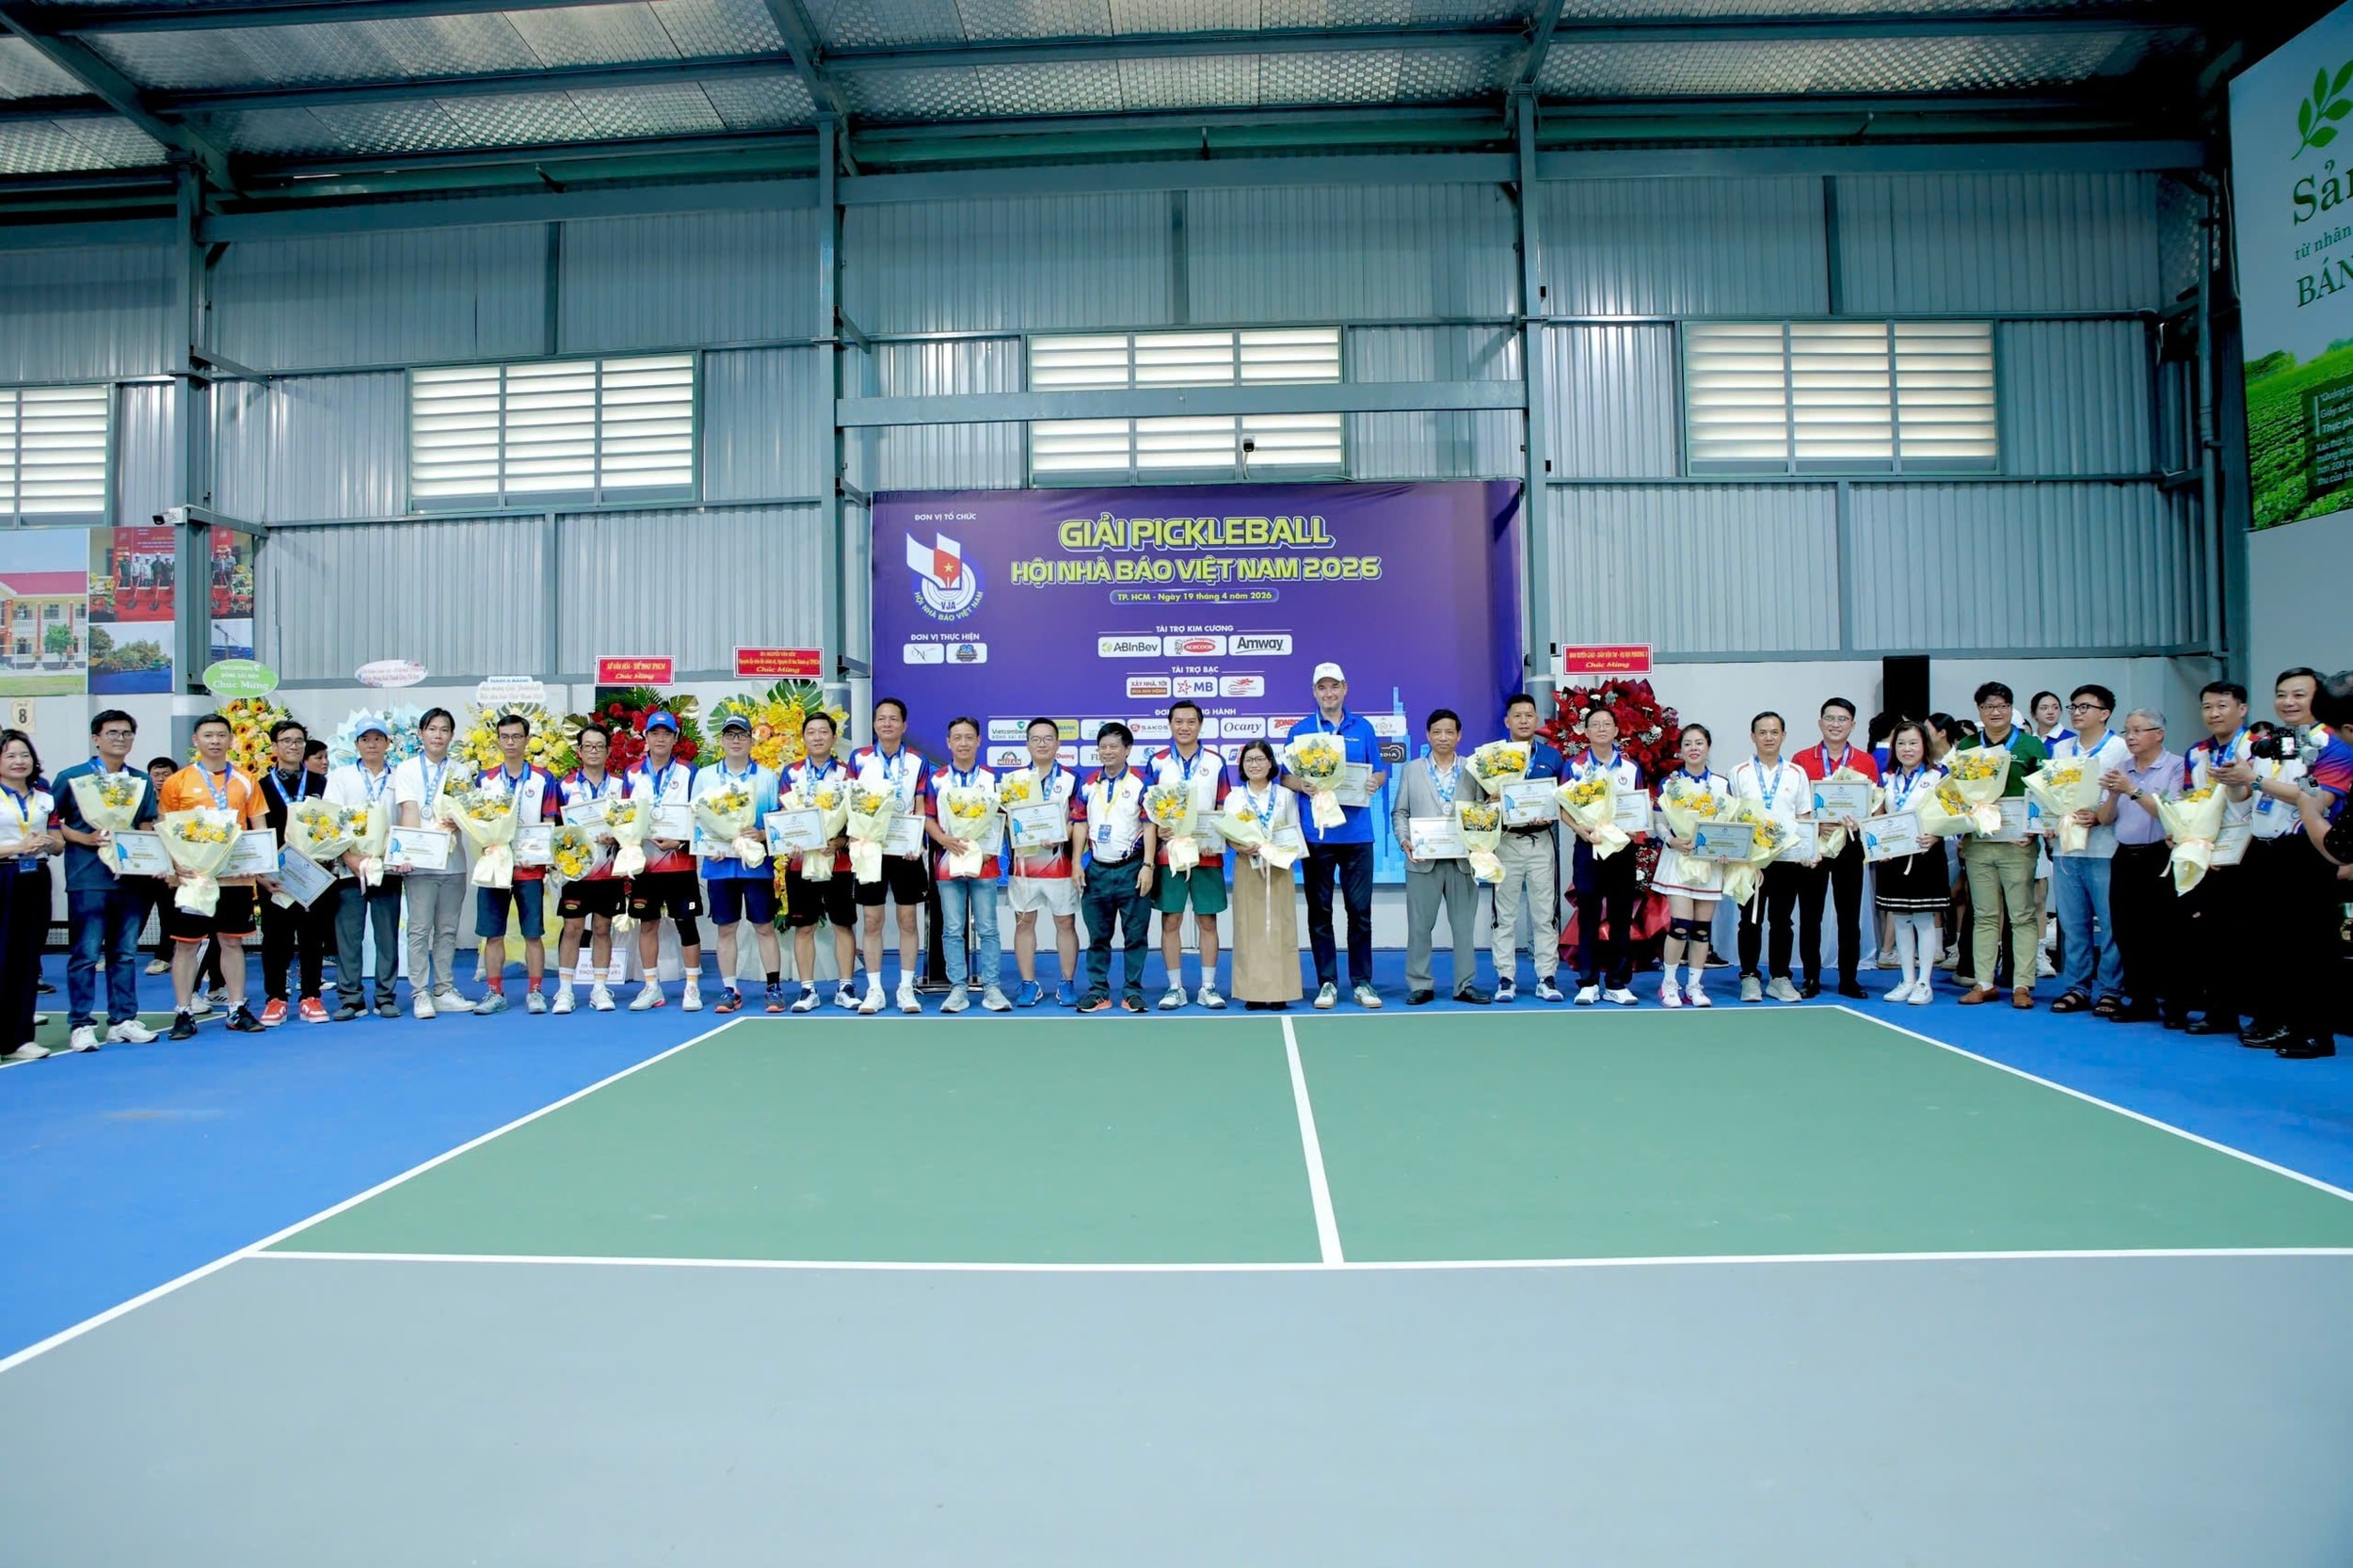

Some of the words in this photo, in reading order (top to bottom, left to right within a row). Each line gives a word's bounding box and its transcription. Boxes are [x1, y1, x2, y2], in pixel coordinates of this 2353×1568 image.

[934, 514, 942, 522] VỊ
[944, 511, 954, 520] TỔ
[955, 512, 977, 520] CHỨC
[1060, 514, 1127, 551] GIẢI
[1130, 517, 1335, 550] PICKLEBALL
[1012, 559, 1054, 587] HỘI
[1058, 557, 1114, 584] NHÀ
[1115, 557, 1175, 583] BÁO
[1176, 556, 1236, 588] VIỆT
[1238, 558, 1302, 581] NAM
[1303, 556, 1382, 580] 2026
[1131, 593, 1151, 601] HCM
[1158, 593, 1180, 603] Ngày
[1195, 592, 1220, 602] tháng
[1222, 592, 1228, 600] 4
[1250, 592, 1273, 600] 2026
[938, 611, 955, 621] BÁO
[971, 591, 984, 608] NAM
[941, 601, 956, 610] VJA
[1156, 625, 1168, 633] TÀI
[1170, 625, 1185, 633] TRỢ
[1204, 624, 1234, 632] CƯƠNG
[930, 633, 939, 642] VỊ
[940, 633, 960, 642] THỰC
[962, 633, 980, 642] HIỆN
[1237, 636, 1284, 651] Amway
[1171, 665, 1184, 674] TÀI
[1185, 666, 1202, 675] TRỢ
[1203, 665, 1219, 675] BẠC
[241, 680, 269, 691] Mừng
[1193, 682, 1213, 693] MB
[19, 708, 27, 724] 8
[1224, 722, 1262, 734] Ocany
